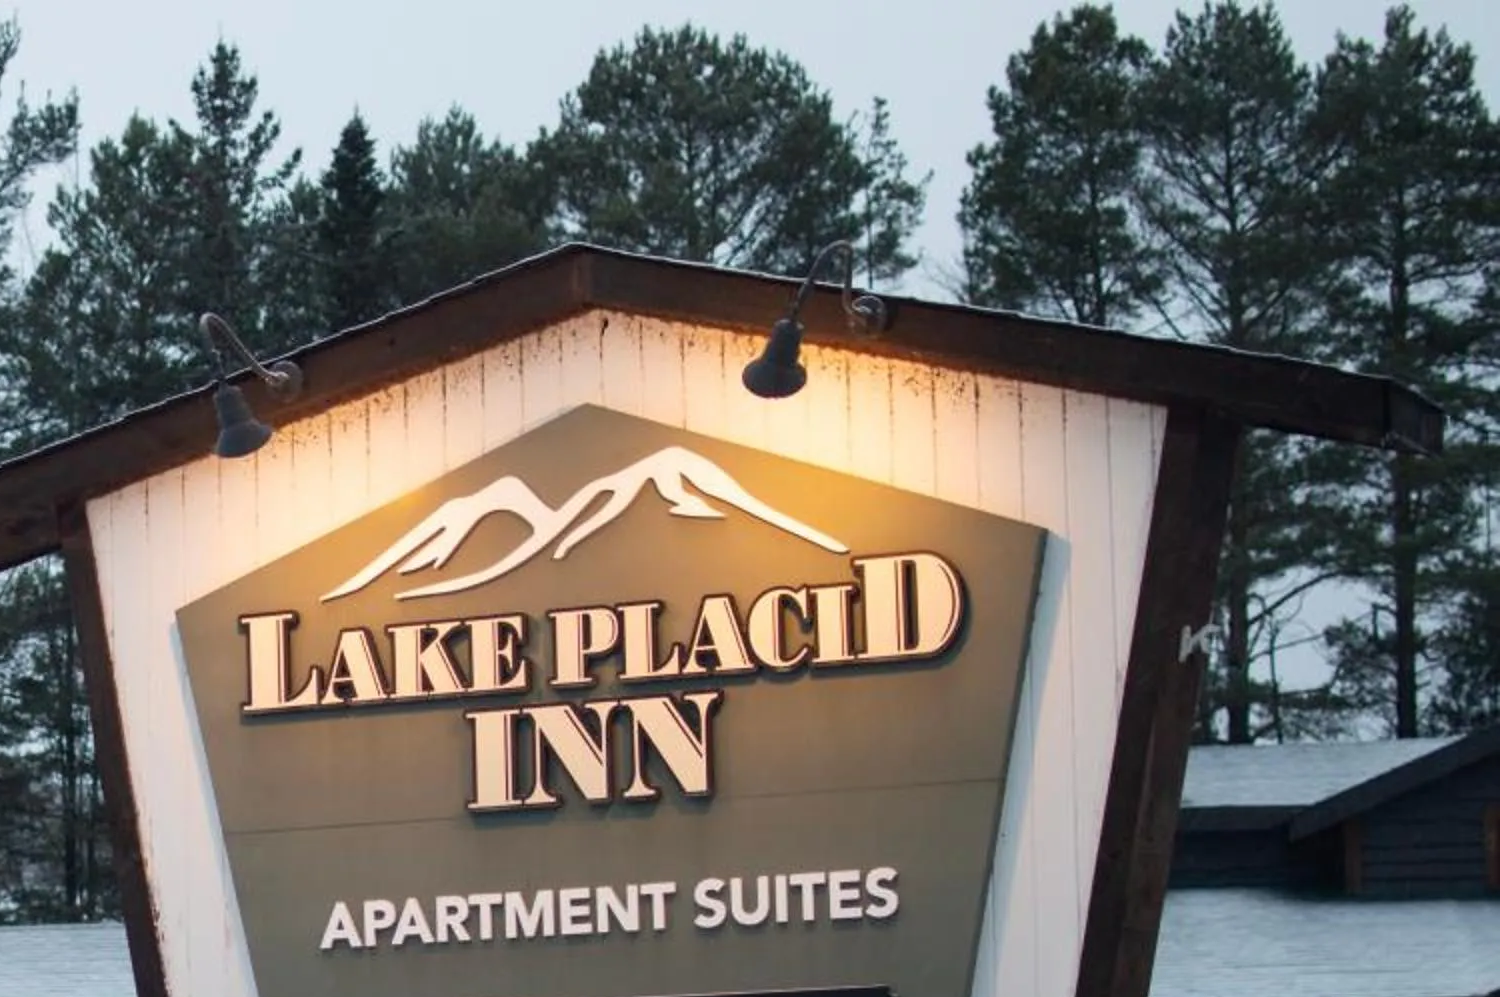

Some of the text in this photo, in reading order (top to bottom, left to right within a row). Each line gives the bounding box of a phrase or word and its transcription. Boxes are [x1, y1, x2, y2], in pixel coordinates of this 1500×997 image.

[239, 550, 968, 714] LAKE PLACID
[466, 690, 723, 813] INN
[320, 867, 900, 950] APARTMENT SUITES
